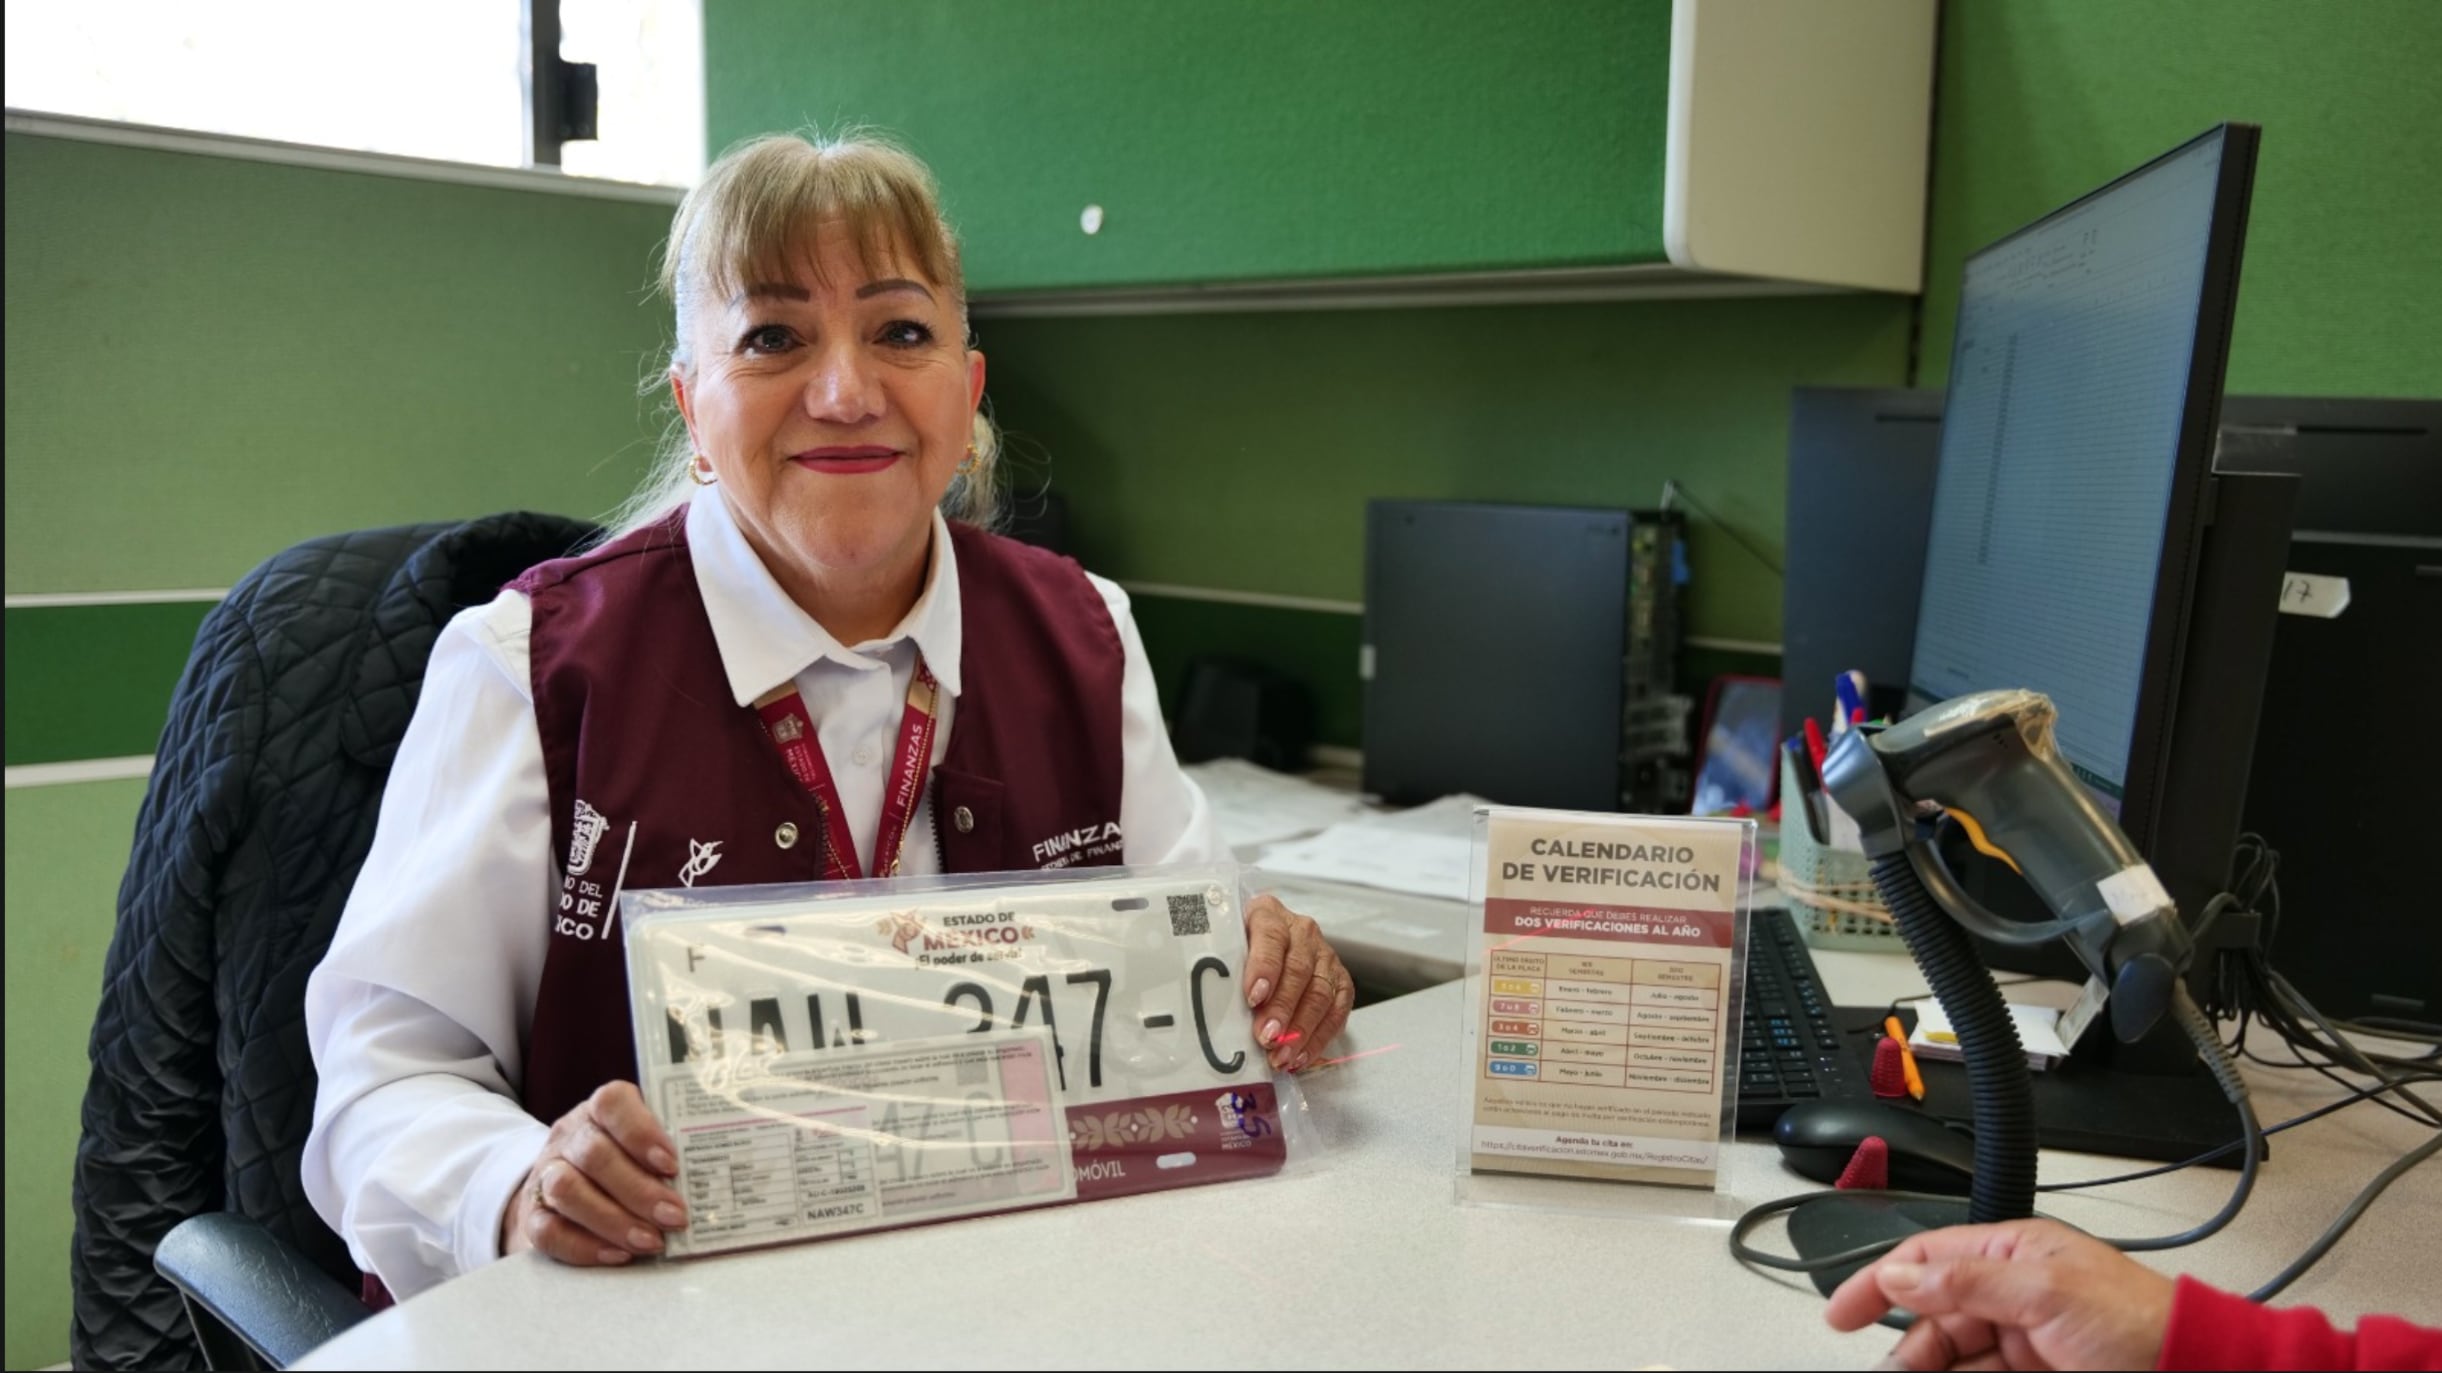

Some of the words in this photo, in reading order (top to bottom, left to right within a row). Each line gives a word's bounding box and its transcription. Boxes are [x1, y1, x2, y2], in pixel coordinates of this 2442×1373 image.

[896, 723, 923, 807] FINANZAS
[1531, 838, 1694, 864] CALENDARIO
[1502, 862, 1535, 881] DE
[1543, 864, 1720, 892] VERIFICACIÓN
[579, 881, 602, 898] DEL
[577, 898, 601, 917] DE
[1530, 906, 1581, 917] RECUERDA
[1583, 909, 1604, 919] QUE
[1606, 910, 1637, 921] DEBES
[1640, 912, 1687, 924] REALIZAR
[943, 913, 996, 927] ESTADO
[998, 912, 1015, 922] DE
[1515, 916, 1542, 928] DOS
[1544, 918, 1649, 934] VERIFICACIONES
[1652, 925, 1669, 936] AL
[1672, 923, 1701, 937] AÑO
[934, 953, 967, 967] poder
[971, 951, 984, 962] de
[1556, 1136, 1590, 1146] Agenda
[1591, 1138, 1600, 1146] tu
[1602, 1140, 1618, 1148] cita
[807, 1203, 864, 1220] NAW347C
